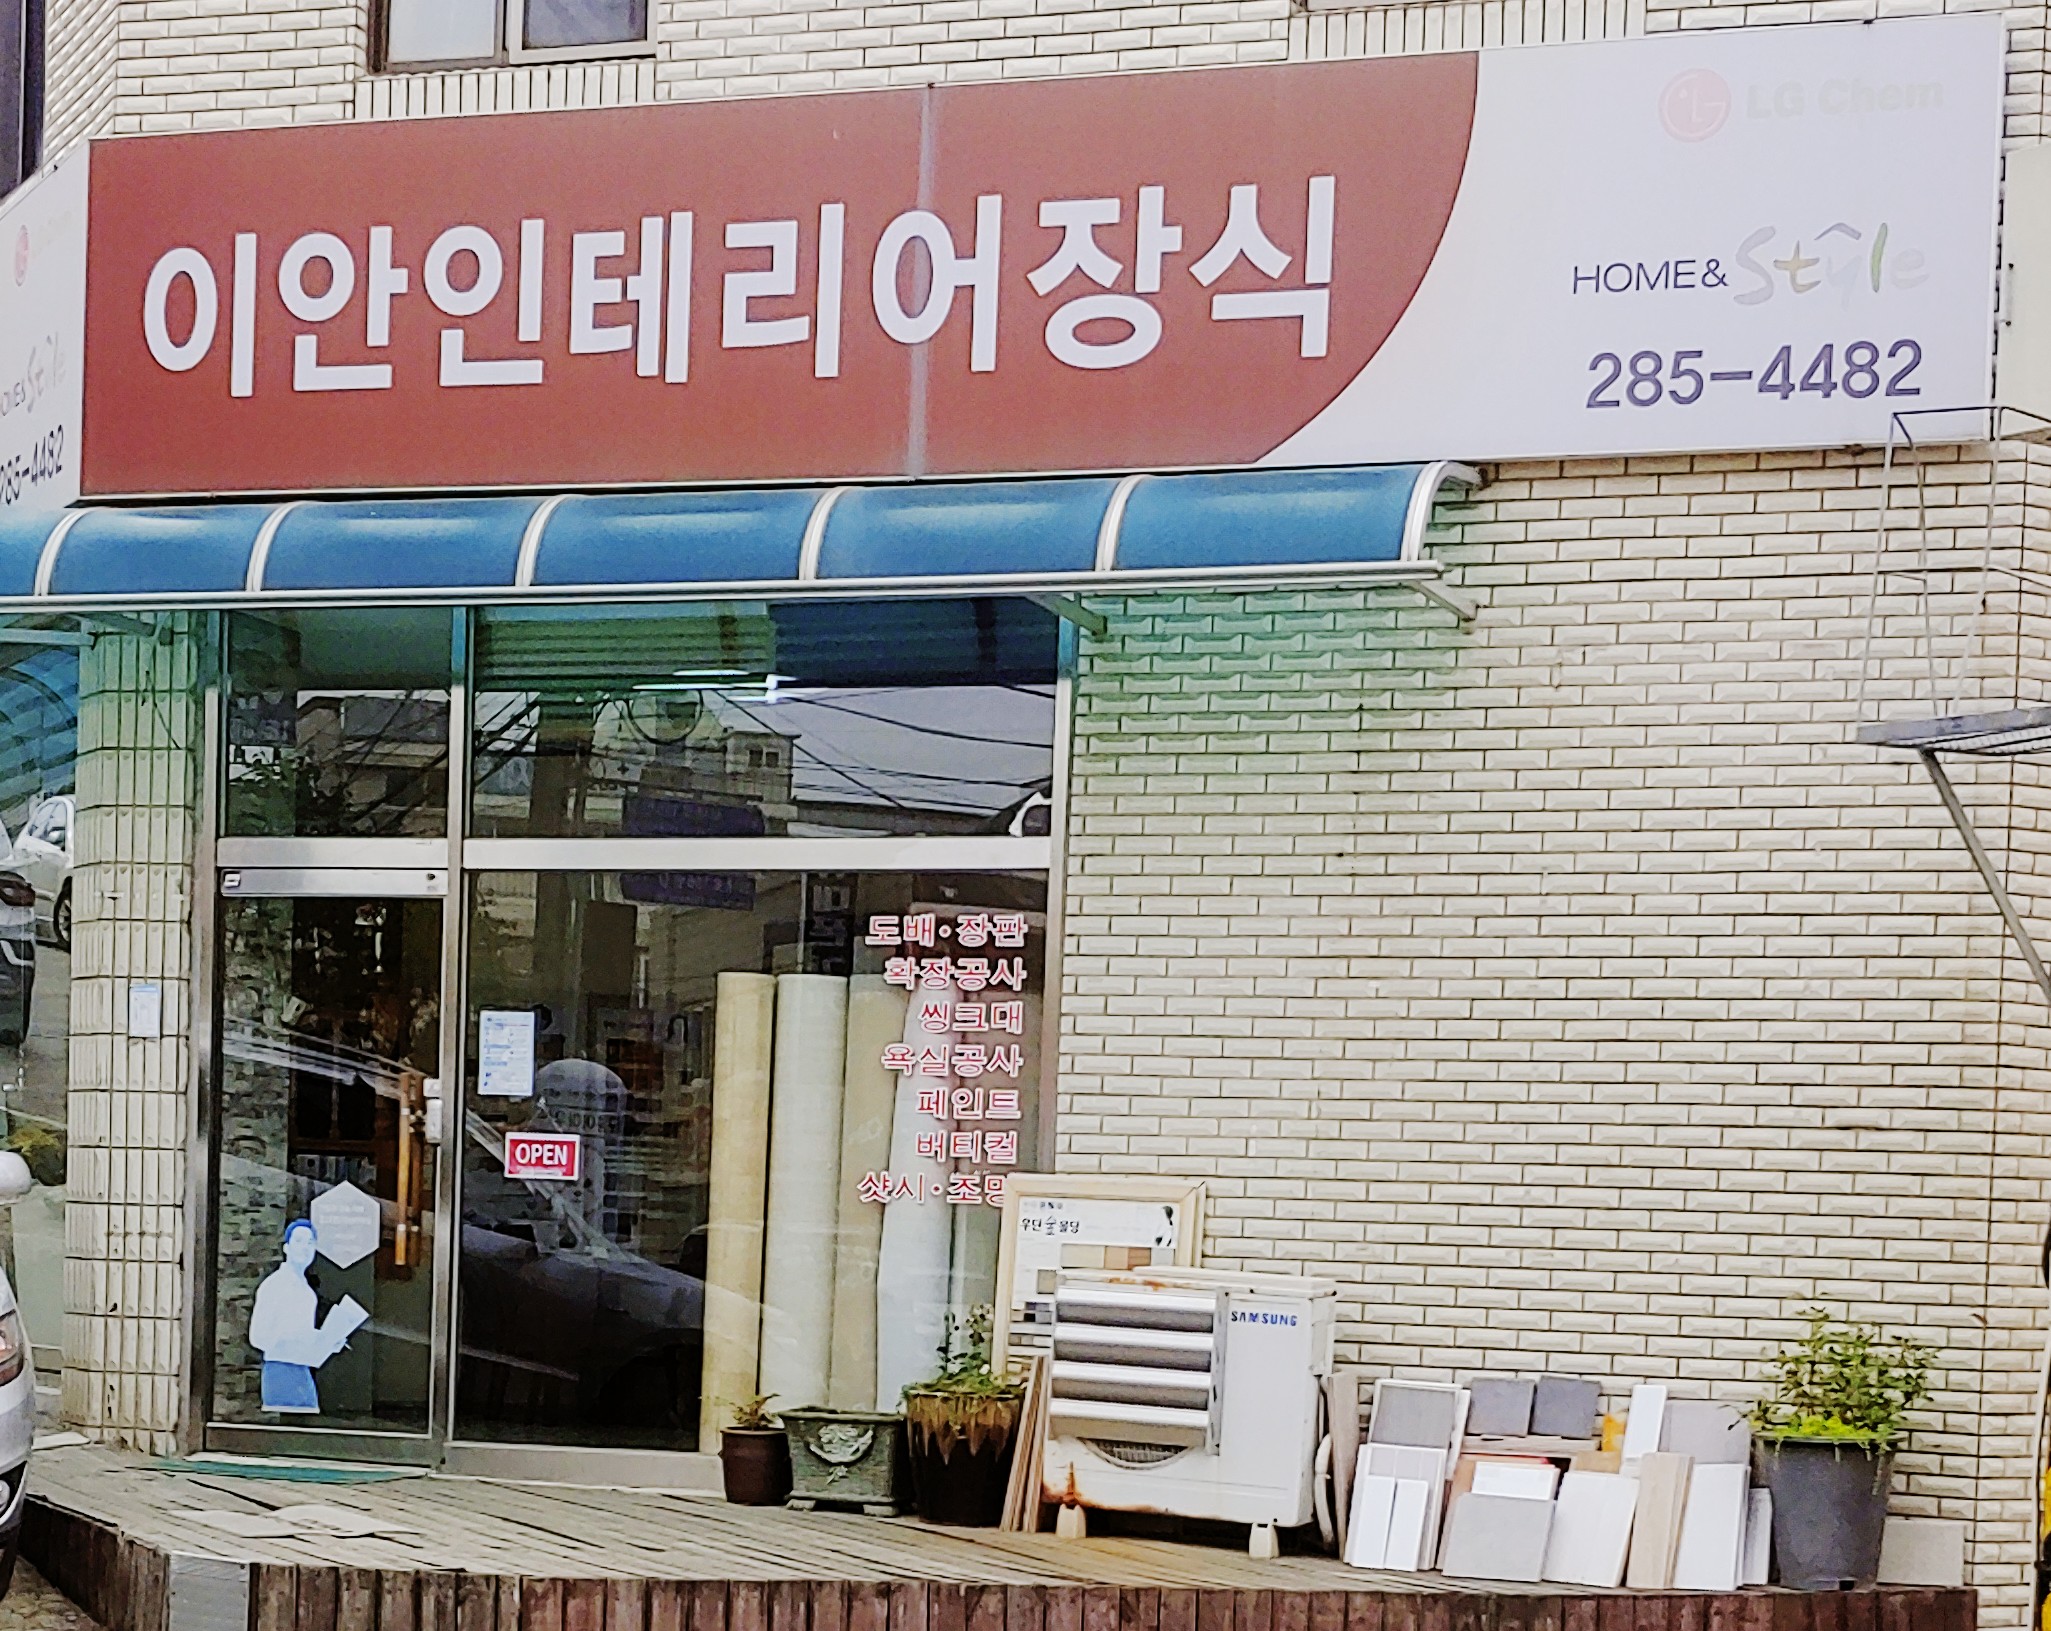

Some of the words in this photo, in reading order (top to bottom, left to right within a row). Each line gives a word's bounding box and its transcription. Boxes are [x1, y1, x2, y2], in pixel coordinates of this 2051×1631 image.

[1746, 79, 1805, 119] LG
[1817, 76, 1944, 116] Chem
[143, 174, 1338, 400] 이안인테리어장식
[1585, 338, 1923, 409] 285-4482
[883, 956, 1028, 992] 확장공사
[918, 1000, 1024, 1035] 씽크대
[881, 1043, 1025, 1078] 욕실공사
[916, 1087, 1022, 1121] 페인트
[514, 1142, 569, 1166] OPEN
[915, 1130, 1018, 1165] 버티컬
[1230, 1305, 1298, 1327] SAMSUNG
